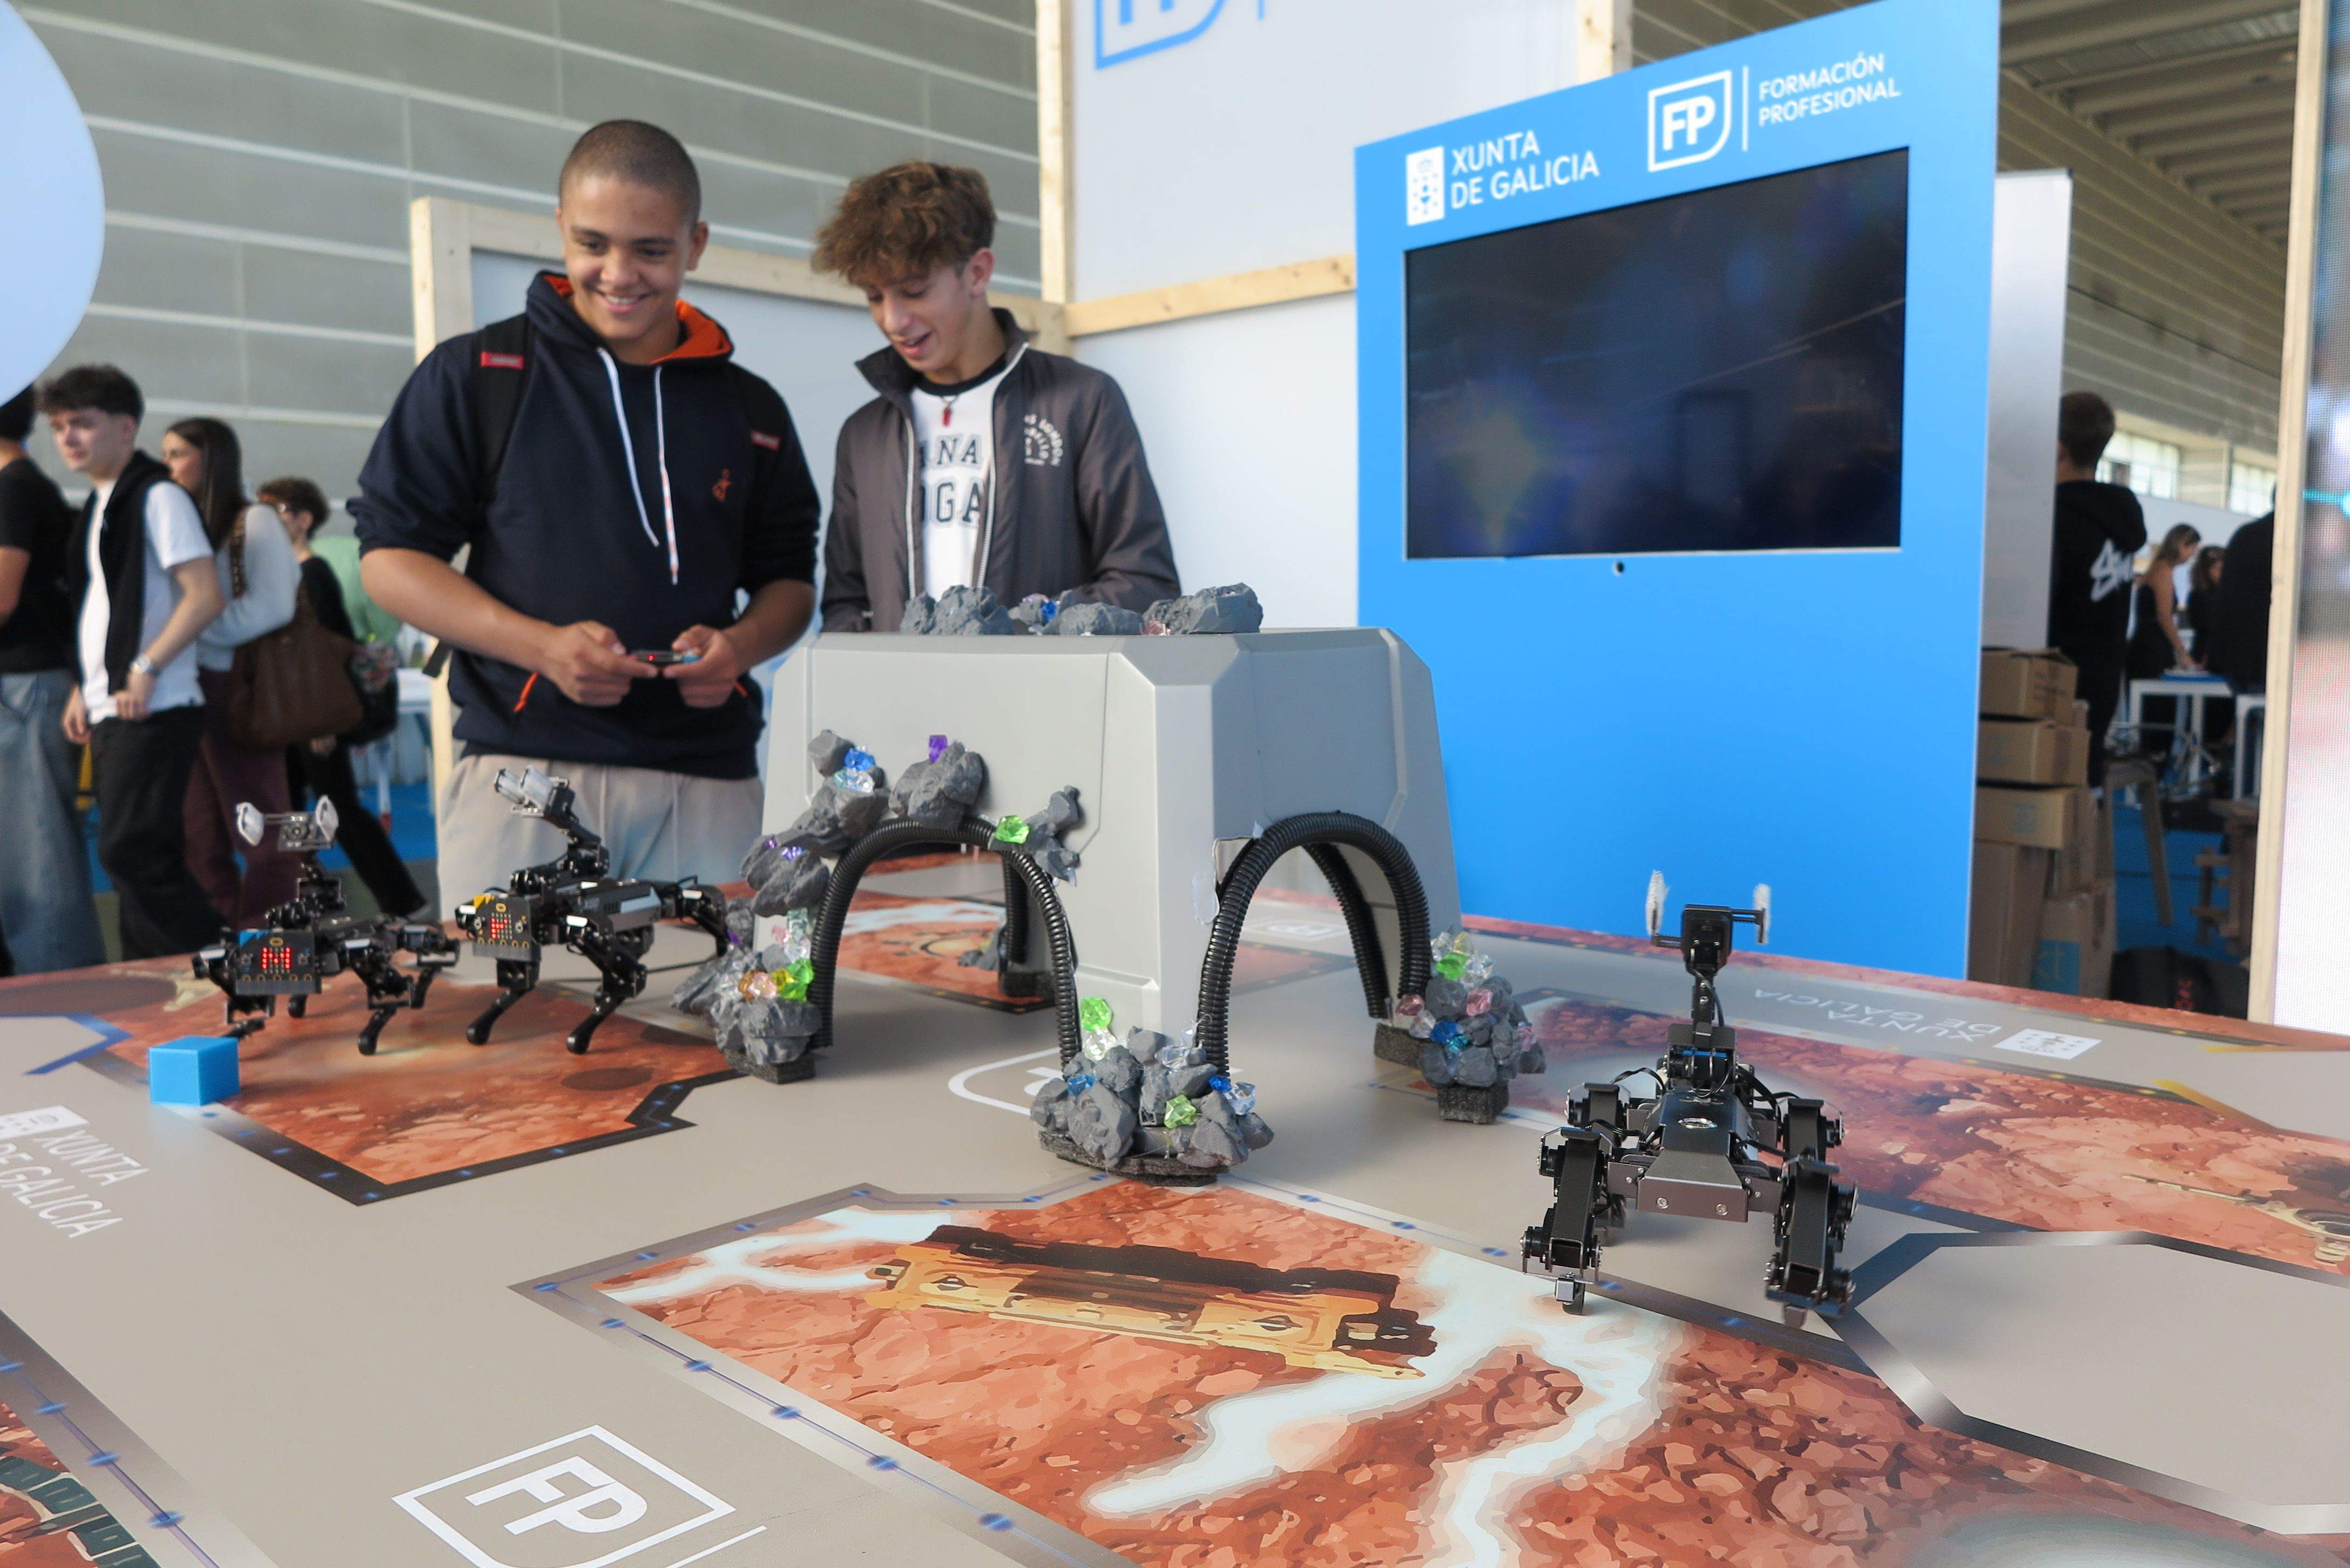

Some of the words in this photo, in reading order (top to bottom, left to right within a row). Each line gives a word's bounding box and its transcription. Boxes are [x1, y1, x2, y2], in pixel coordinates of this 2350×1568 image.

[1759, 52, 1886, 102] FORMACIÓN
[1759, 77, 1902, 127] PROFESIONAL
[1663, 95, 1716, 151] FP
[1451, 129, 1541, 176] XUNTA
[1450, 176, 1484, 209] DE
[1490, 150, 1600, 200] GALICIA
[1754, 989, 1924, 1021] GALICIA
[1828, 1010, 1986, 1042] XUNTA
[1934, 1017, 2002, 1034] DE
[33, 1129, 150, 1187] XUNTA
[464, 1456, 648, 1536] FP
